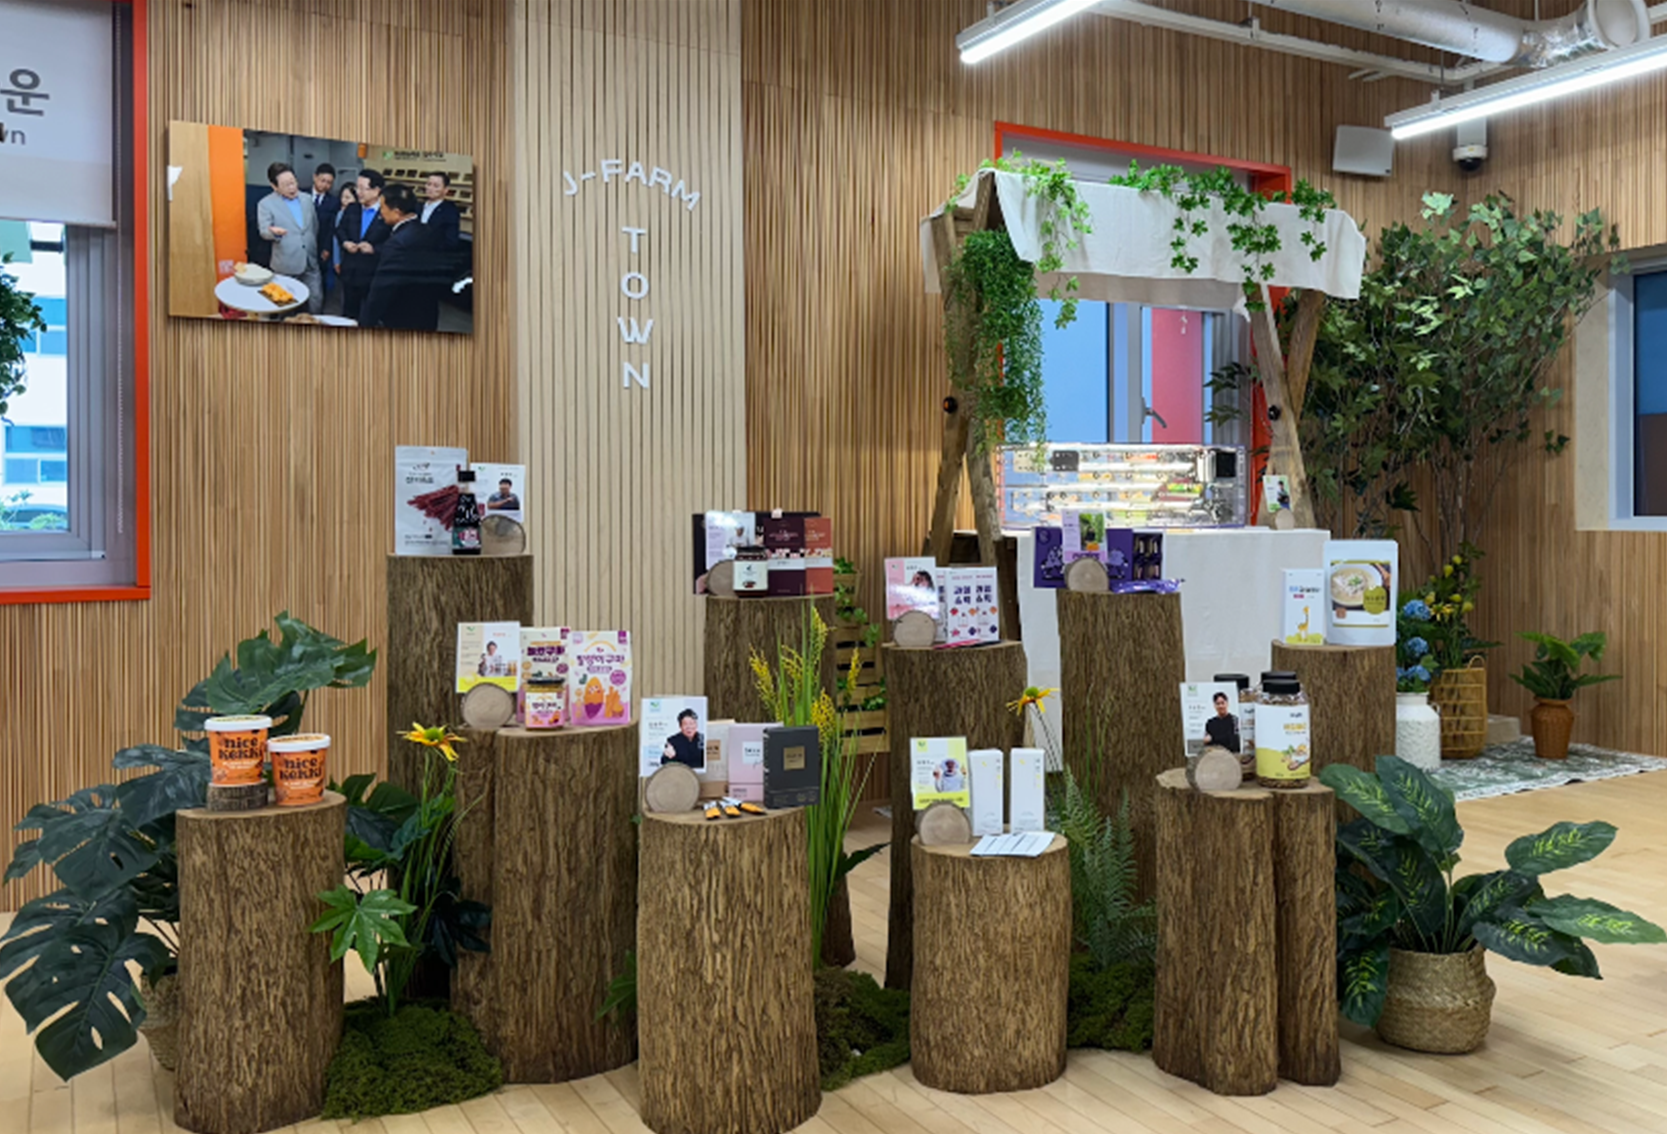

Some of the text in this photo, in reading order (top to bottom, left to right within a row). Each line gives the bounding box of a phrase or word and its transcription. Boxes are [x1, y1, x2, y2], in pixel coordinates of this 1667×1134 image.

[563, 159, 701, 211] J-FARM
[617, 226, 653, 389] TOWN
[225, 737, 258, 748] nice
[284, 757, 318, 769] nice
